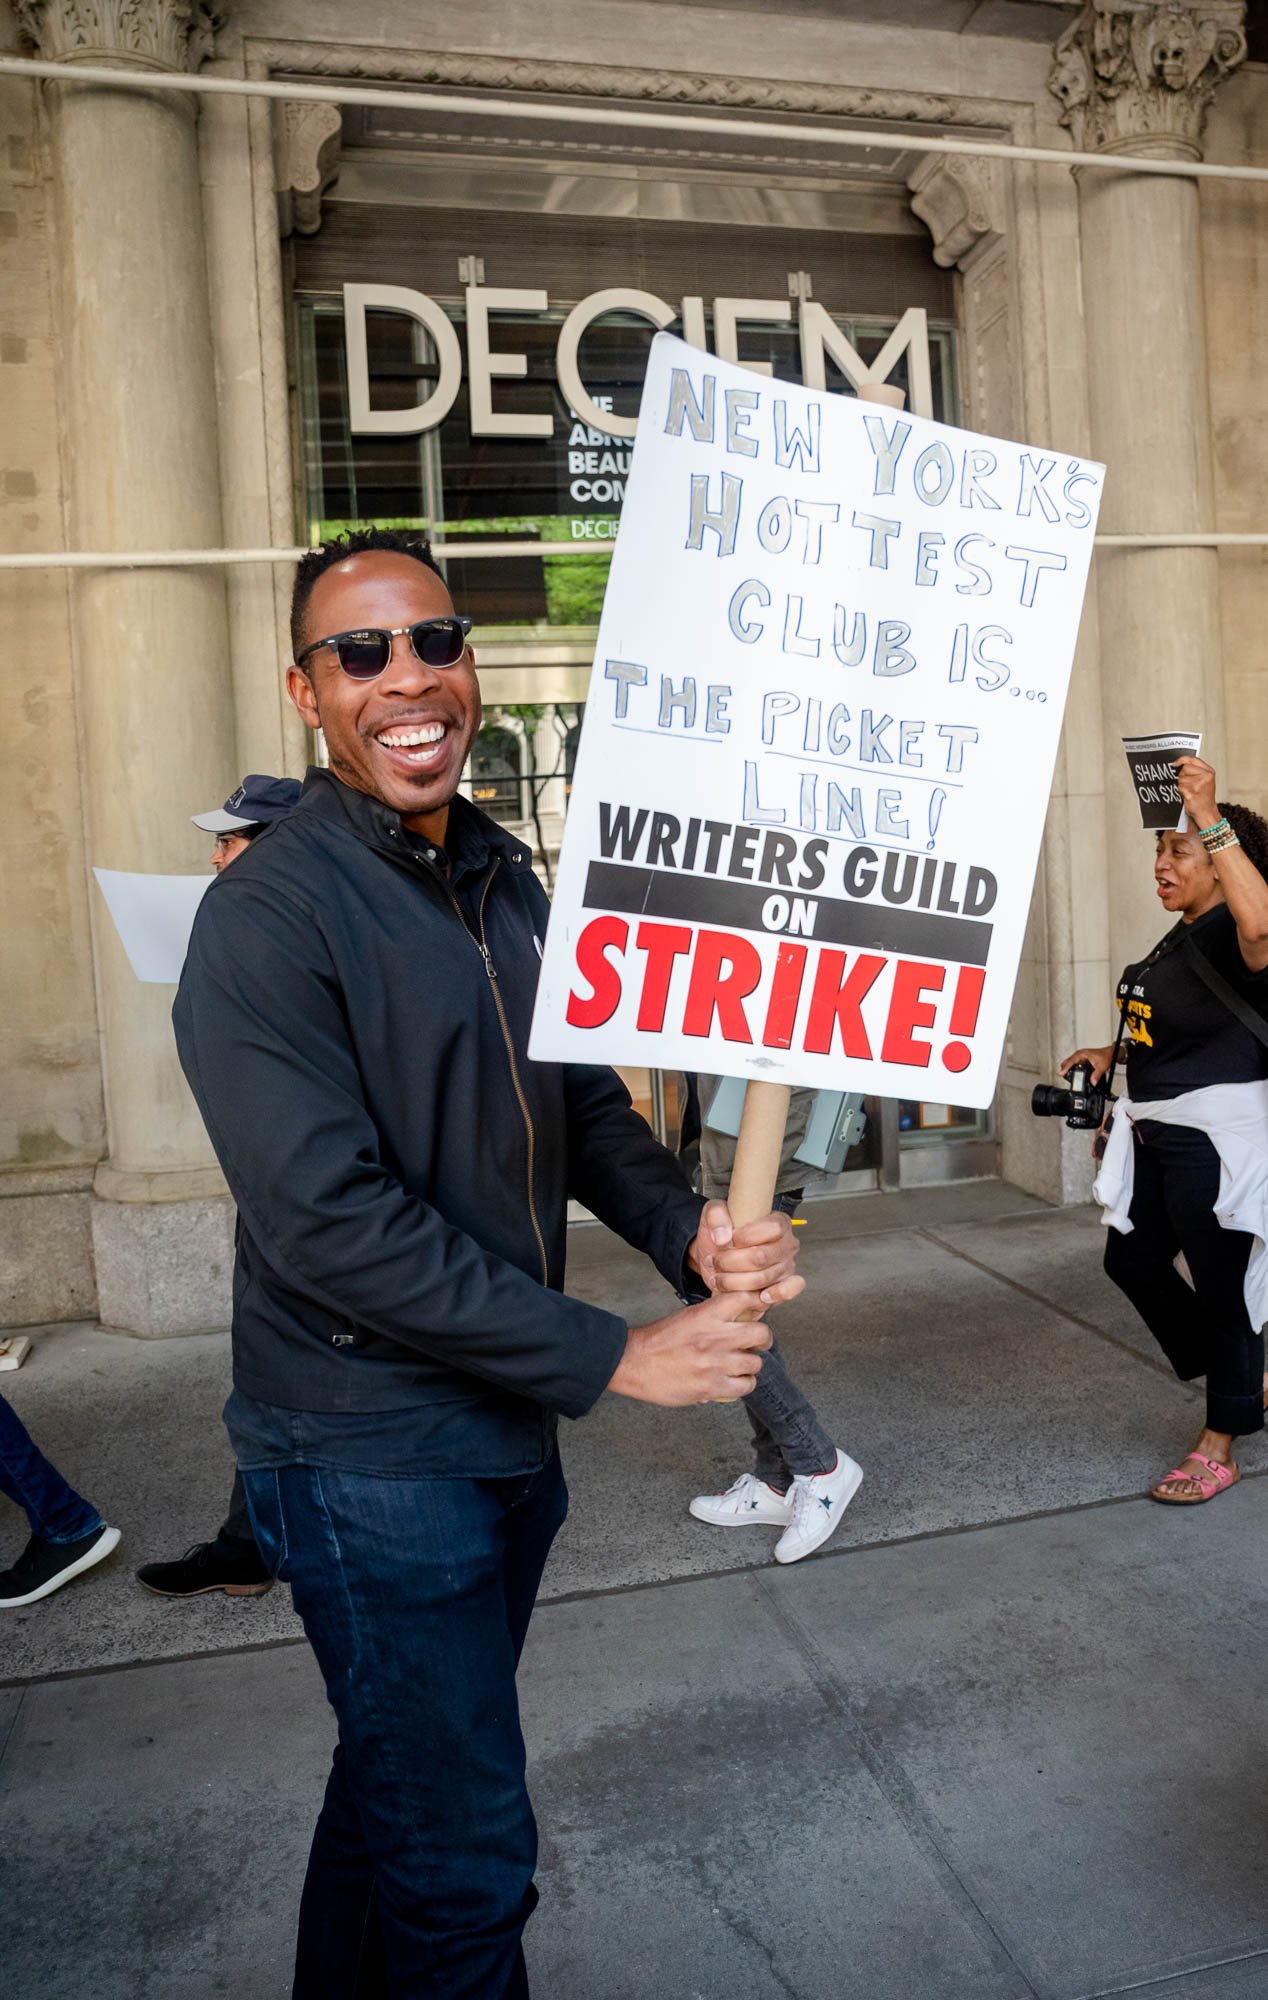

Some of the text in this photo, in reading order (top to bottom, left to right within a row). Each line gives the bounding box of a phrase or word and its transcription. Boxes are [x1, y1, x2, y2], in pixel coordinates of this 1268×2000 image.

[568, 424, 634, 446] ABN
[568, 451, 632, 474] BEAU
[664, 368, 1097, 529] NEW YORK'S
[685, 471, 1067, 607] HOTTEST
[728, 579, 1048, 703] CLUB IS...
[604, 659, 978, 772] THE PICKET
[742, 760, 947, 850] LINE!
[1135, 762, 1179, 782] SHAME
[1138, 786, 1161, 804] ON
[599, 802, 998, 917] WRITERS GUILD
[761, 895, 818, 936] ON
[566, 915, 986, 1073] STRIKE!
